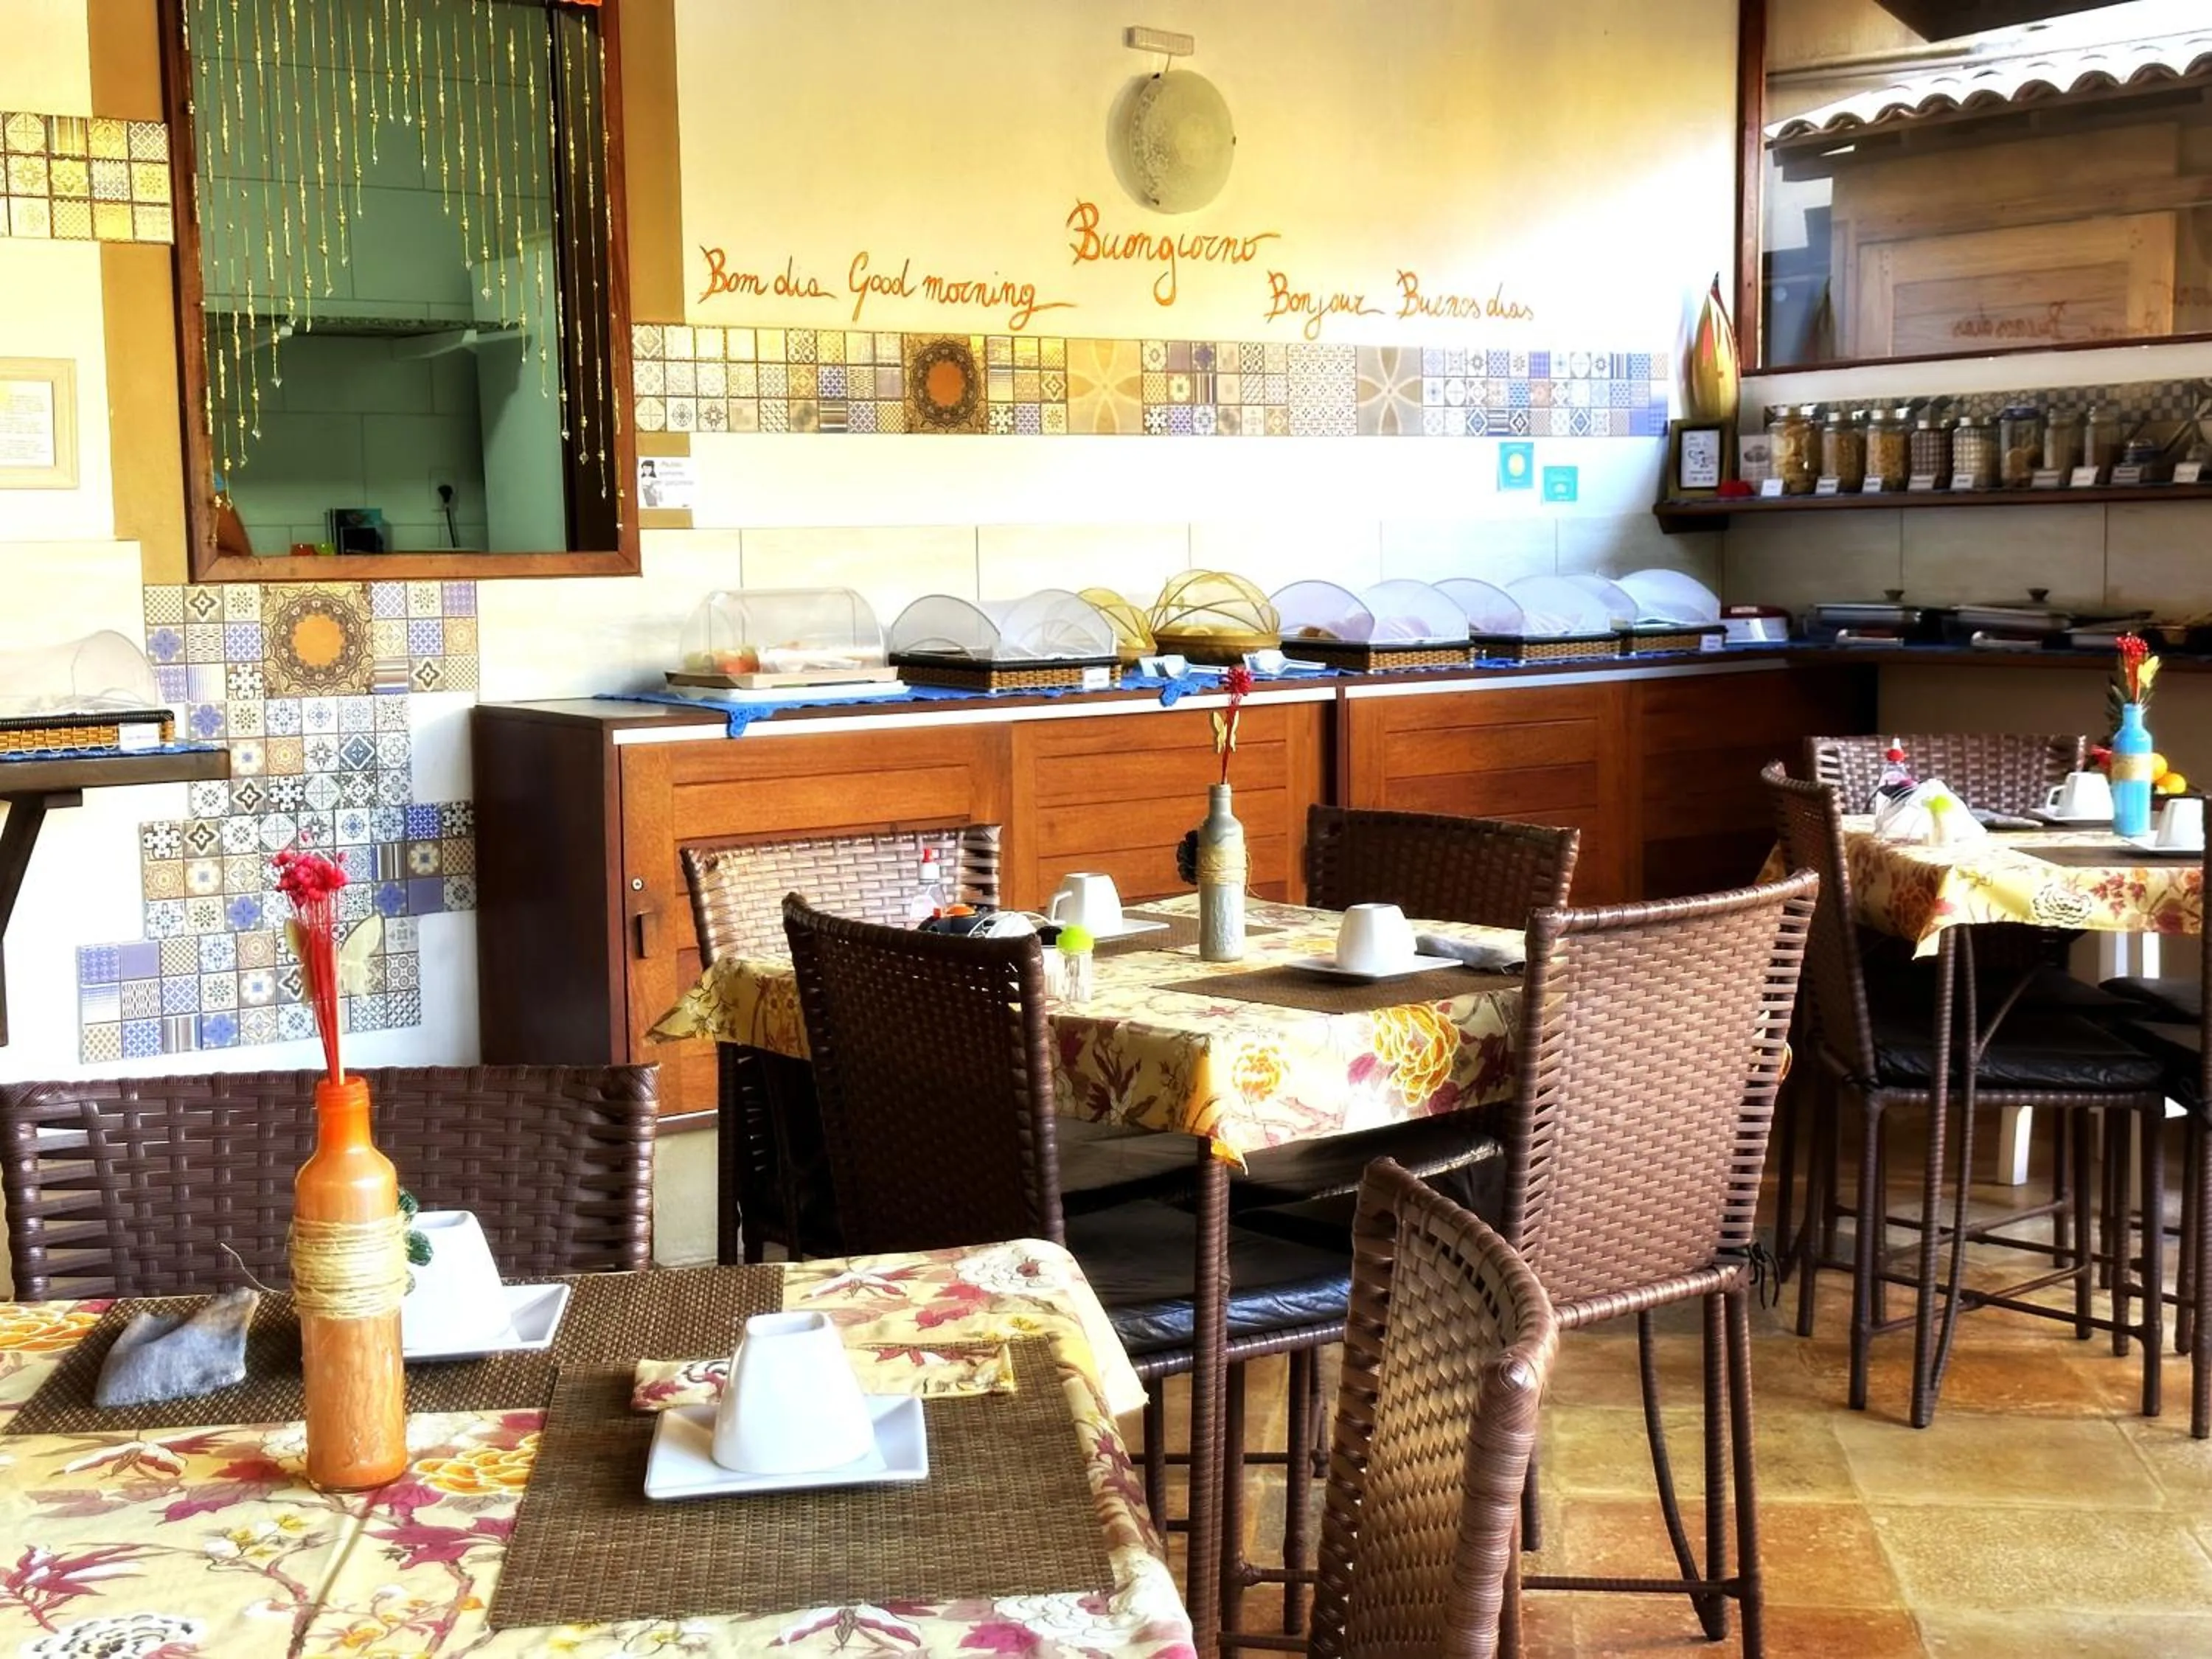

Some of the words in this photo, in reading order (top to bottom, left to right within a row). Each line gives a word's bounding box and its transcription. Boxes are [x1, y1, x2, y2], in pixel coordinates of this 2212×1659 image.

[698, 246, 768, 304] Bom
[774, 256, 837, 299] dia
[1066, 198, 1281, 306] Buongiorno
[849, 251, 915, 322] Good
[922, 271, 1077, 331] morning
[1263, 270, 1385, 341] Bonjour
[1397, 268, 1481, 320] Buenos
